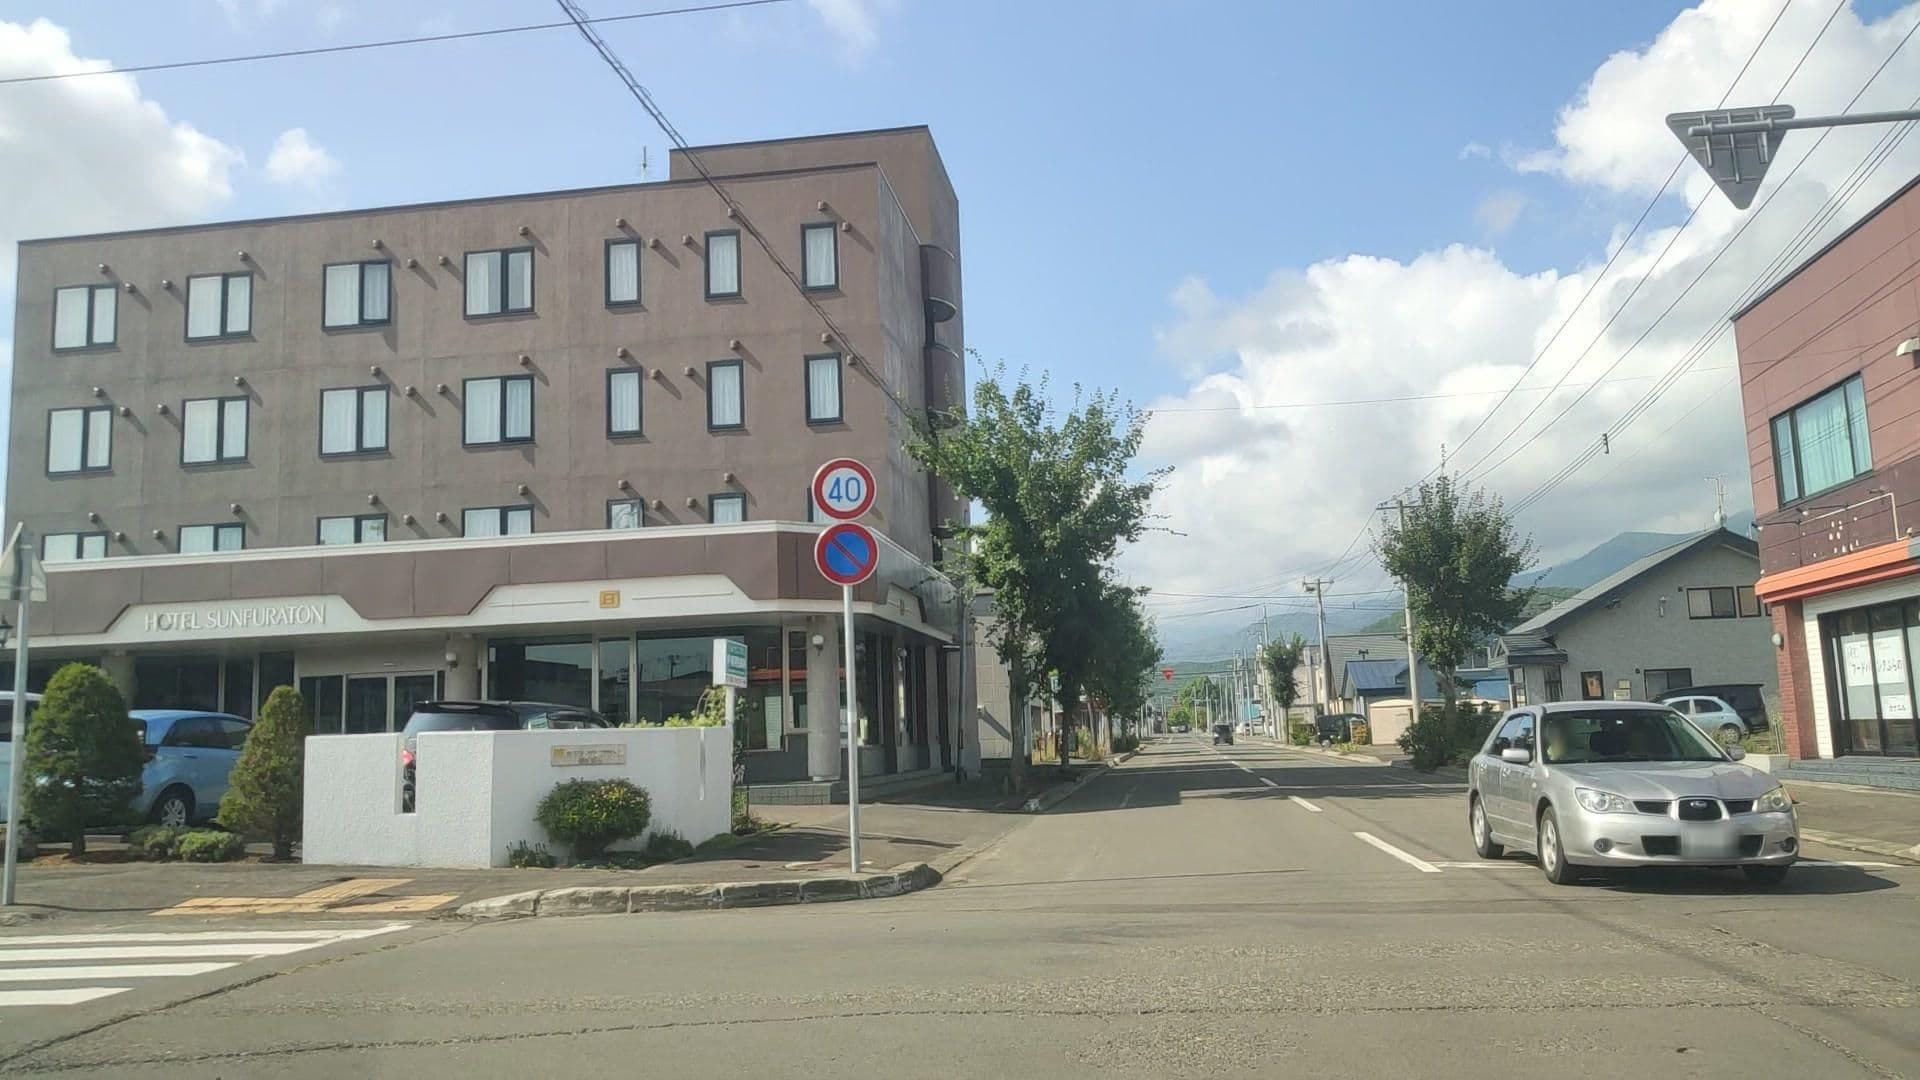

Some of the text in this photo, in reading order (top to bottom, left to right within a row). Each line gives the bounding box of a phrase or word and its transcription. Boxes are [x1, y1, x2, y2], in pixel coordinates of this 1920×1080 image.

[828, 476, 861, 502] 40
[145, 602, 326, 631] HOTEL SUNFURATON
